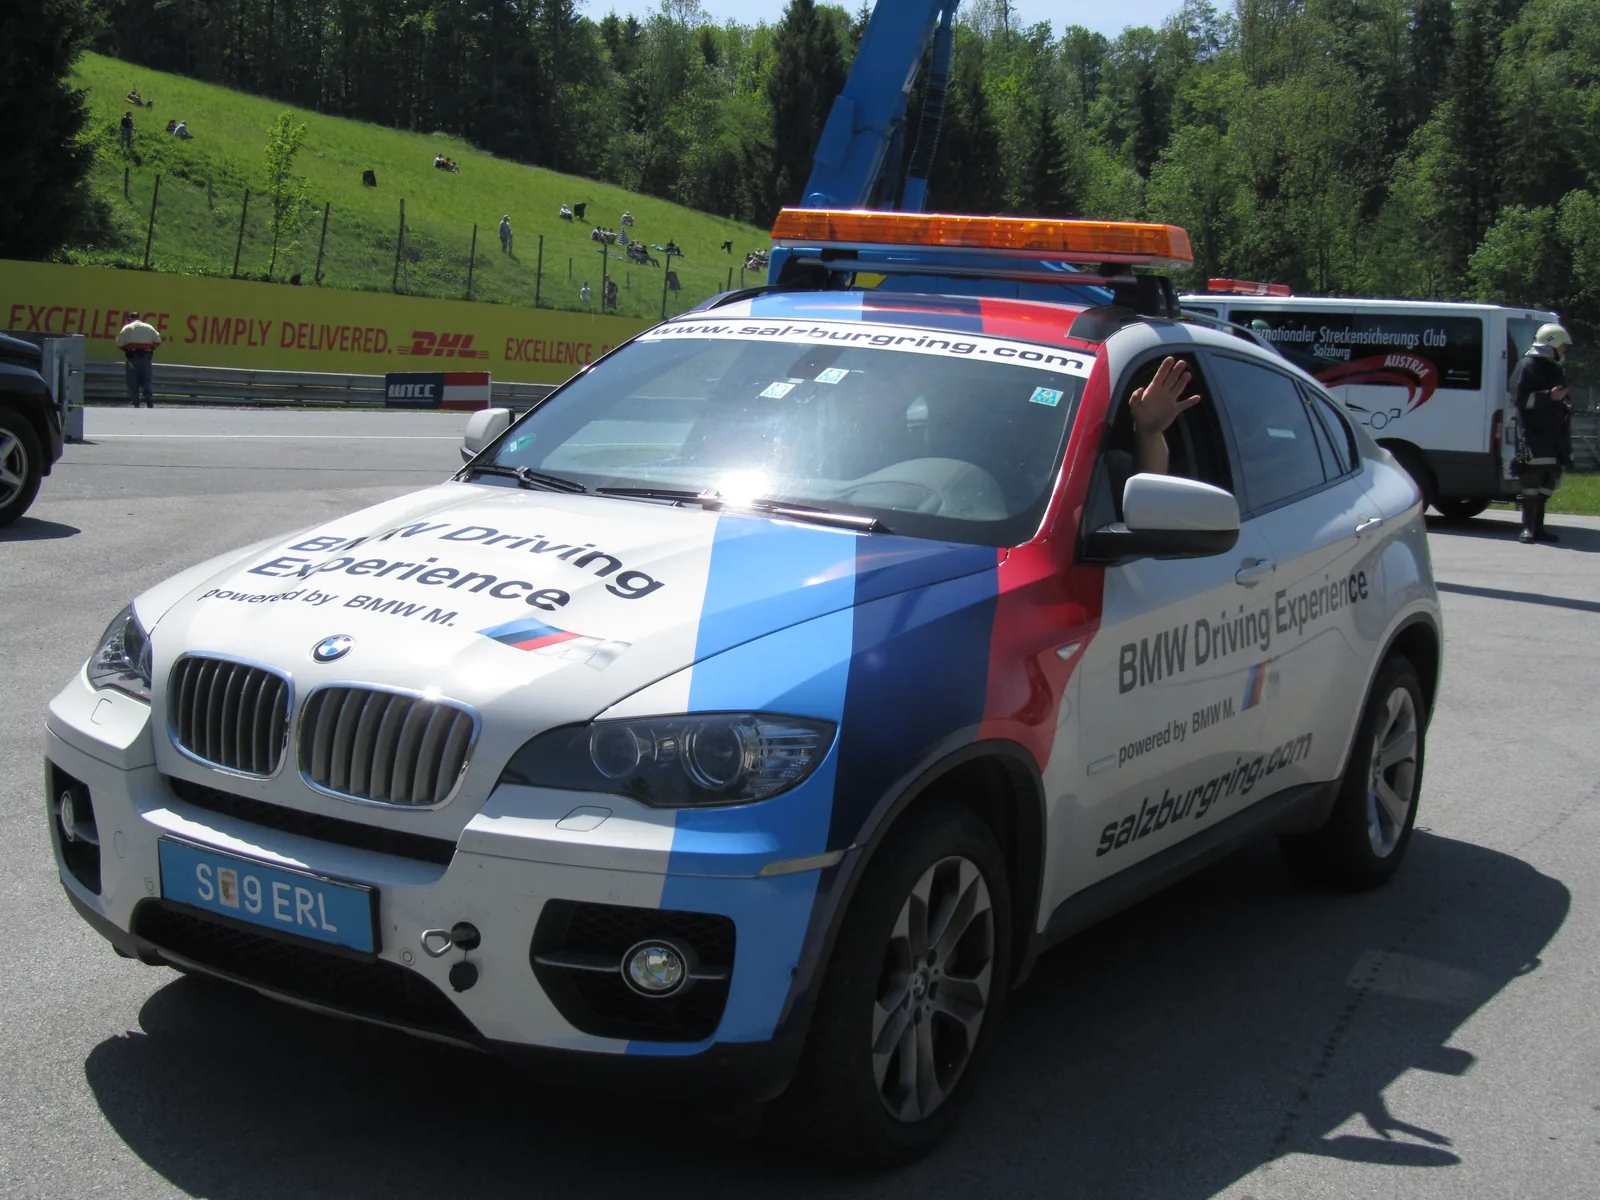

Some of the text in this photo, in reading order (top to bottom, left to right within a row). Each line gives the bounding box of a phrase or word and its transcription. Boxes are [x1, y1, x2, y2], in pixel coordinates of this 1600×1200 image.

[184, 314, 273, 347] SIMPLY
[279, 321, 392, 354] DELIVERED.
[410, 330, 478, 359] DHL
[503, 338, 593, 366] EXCELLENCE
[651, 325, 1084, 370] www.salzburgring.com
[1313, 343, 1350, 361] Salzburg
[1319, 325, 1420, 349] Streckensicherungs
[1423, 328, 1448, 347] Club
[1384, 354, 1430, 378] AUSTRIA
[387, 384, 435, 398] WTCC
[437, 525, 665, 600] Driving
[247, 556, 570, 611] Experience
[197, 588, 459, 627] powered by BMW M.
[1118, 623, 1189, 696] BMW
[1194, 604, 1271, 667] Driving
[1274, 570, 1369, 636] Experience
[1118, 697, 1236, 768] powered by BMW M.
[1095, 731, 1313, 858] salzburgring.com
[195, 862, 339, 934] S 9 ERL
